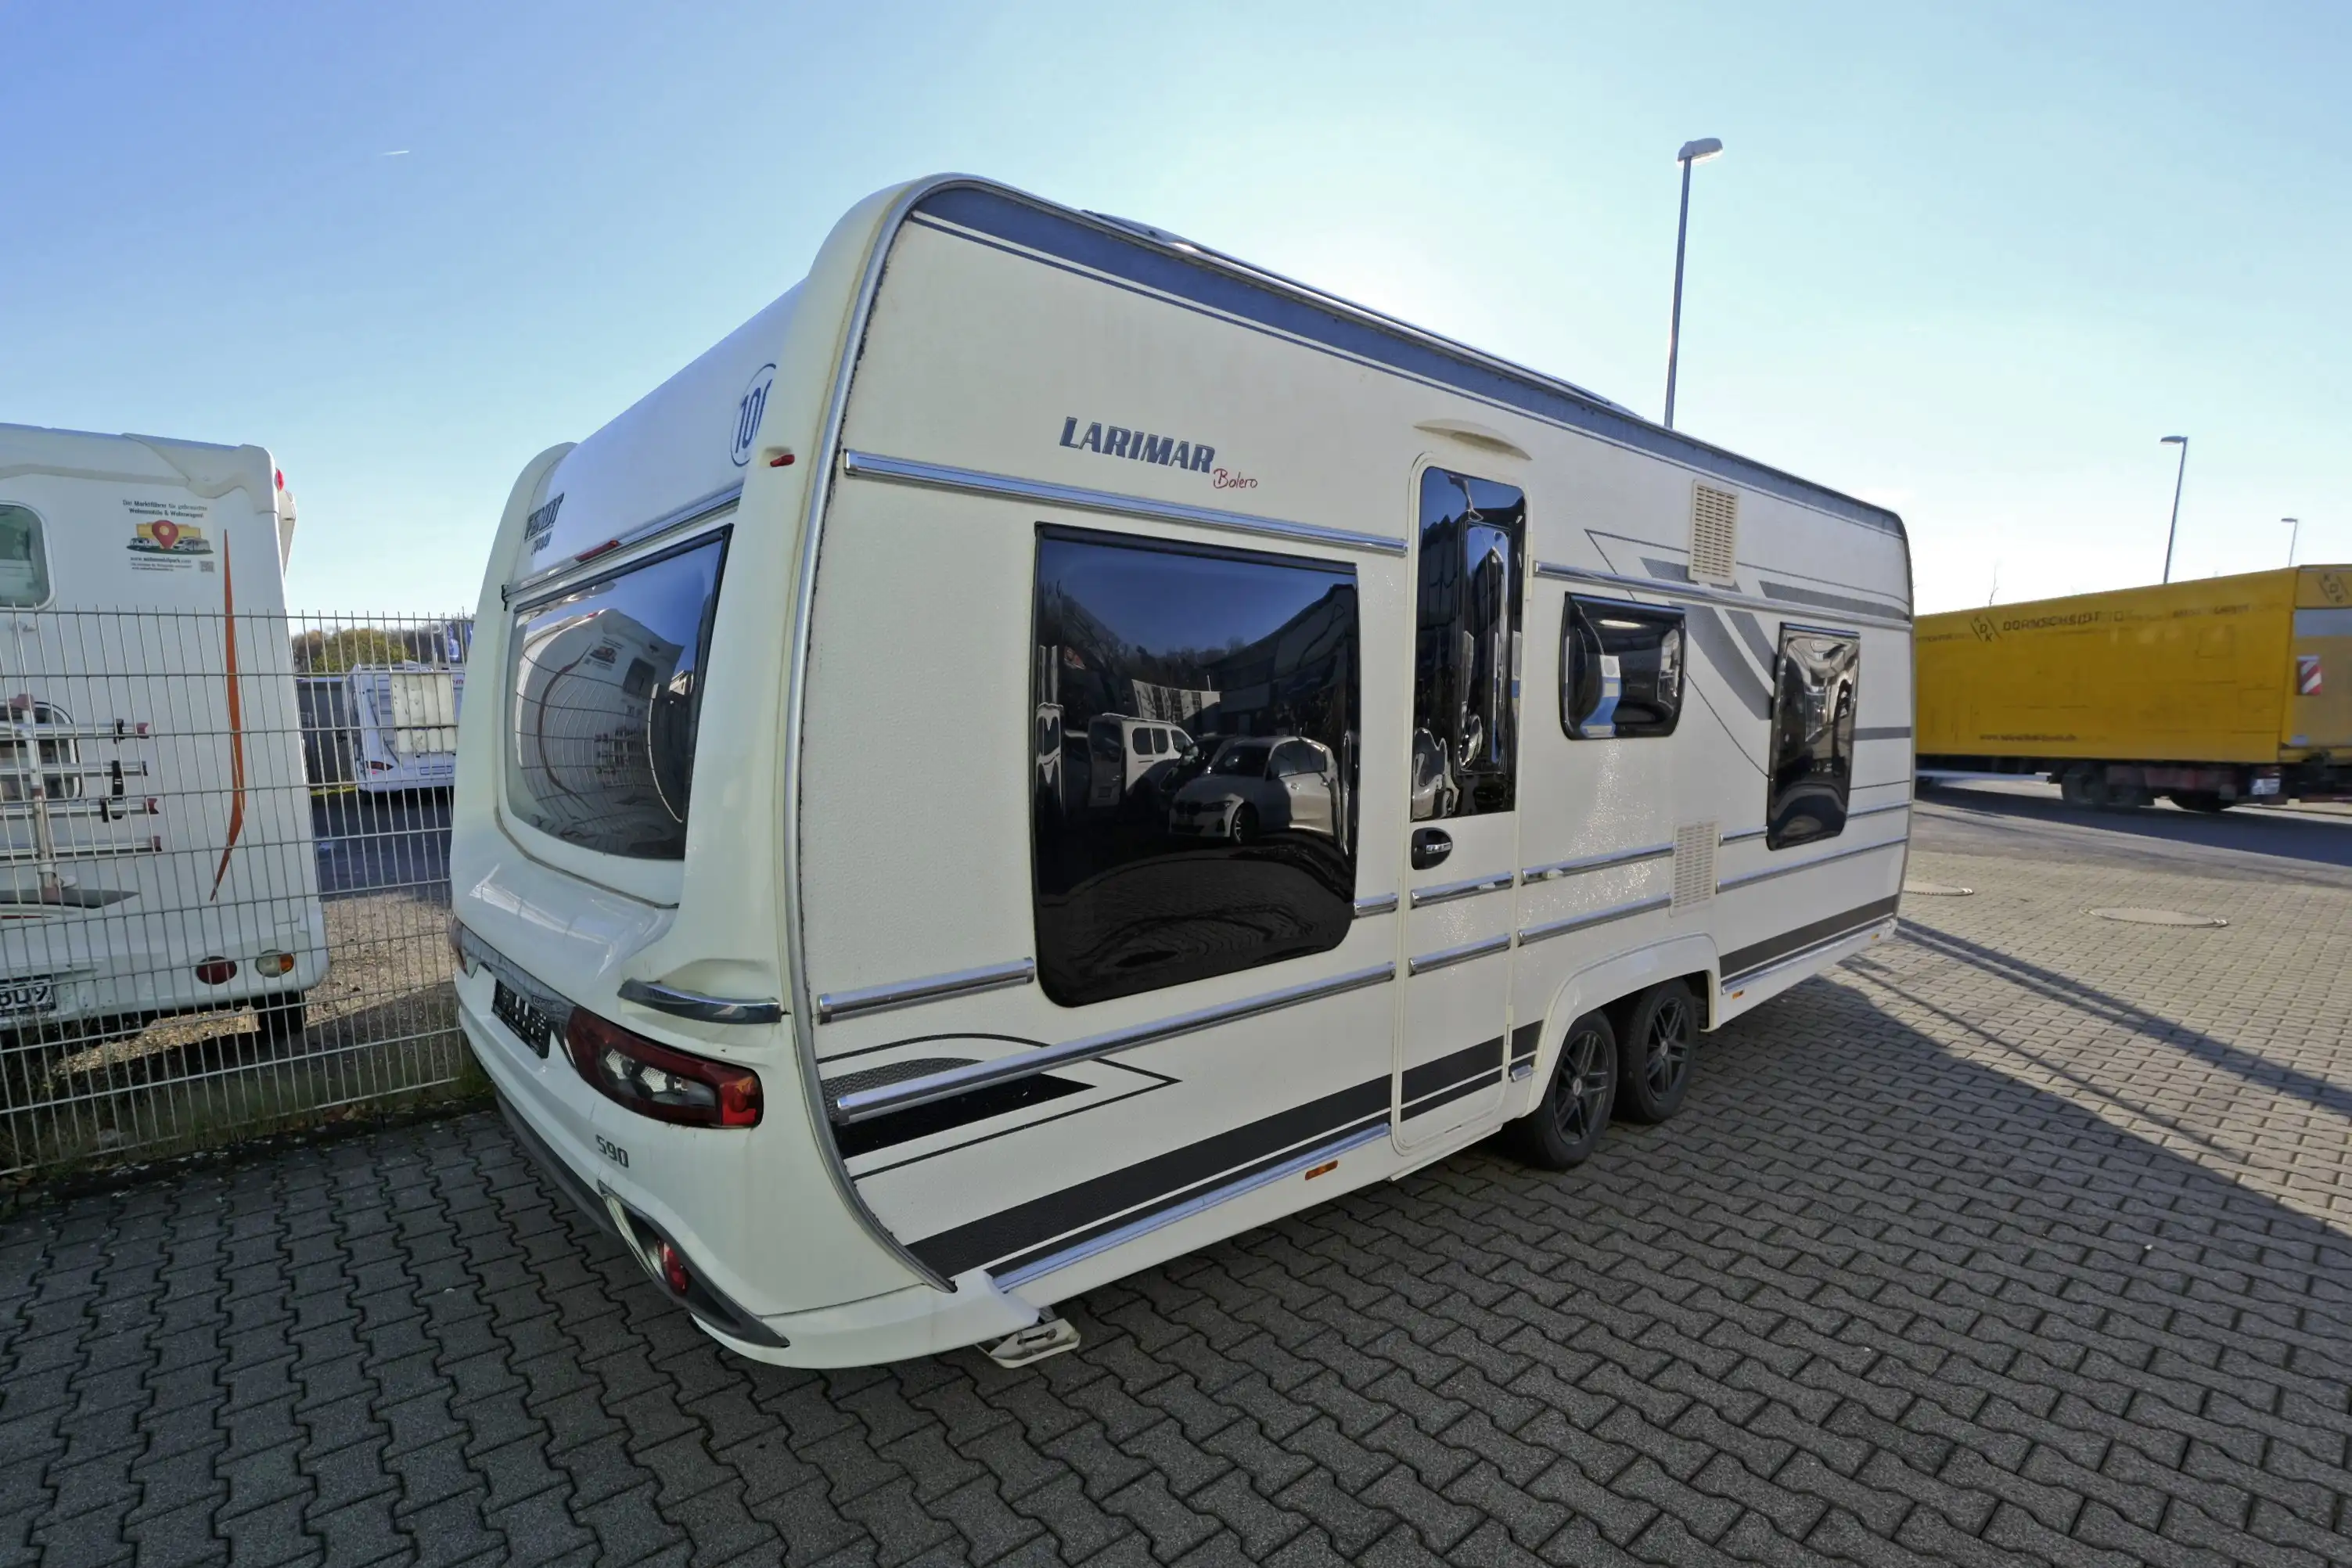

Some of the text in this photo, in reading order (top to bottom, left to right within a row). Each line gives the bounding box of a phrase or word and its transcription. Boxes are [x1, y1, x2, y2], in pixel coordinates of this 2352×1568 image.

[1059, 416, 1258, 489] LARIMAR Bolero
[595, 1135, 630, 1168] 590
